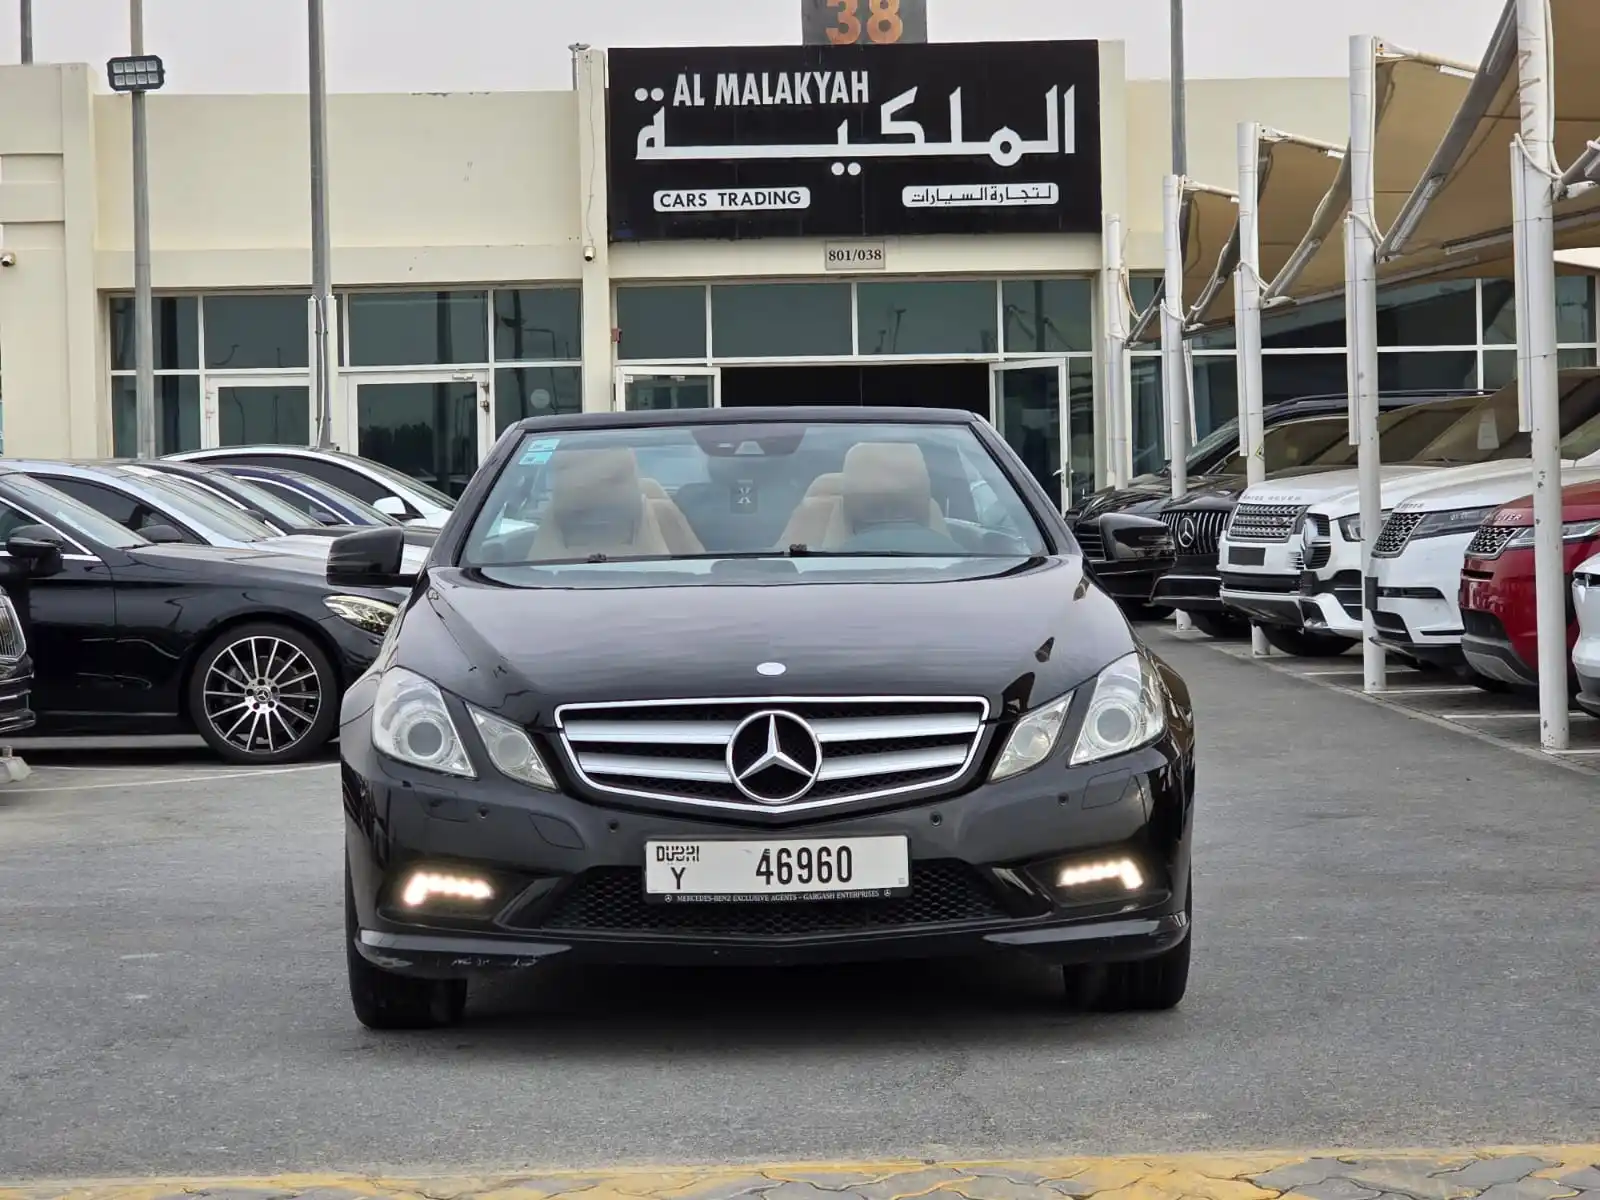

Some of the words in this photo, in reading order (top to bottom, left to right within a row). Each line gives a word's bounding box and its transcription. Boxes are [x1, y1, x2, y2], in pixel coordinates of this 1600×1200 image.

[825, 0, 903, 45] 38
[673, 73, 705, 107] AL
[715, 71, 869, 106] MALAKYAH
[635, 84, 1076, 176] الملكية
[660, 193, 707, 208] CARS
[718, 190, 801, 207] TRADING
[911, 187, 988, 205] السيارات
[990, 184, 1052, 203] لتجارة
[828, 248, 882, 262] 801/038
[755, 845, 853, 886] 46960
[671, 866, 686, 890] Y
